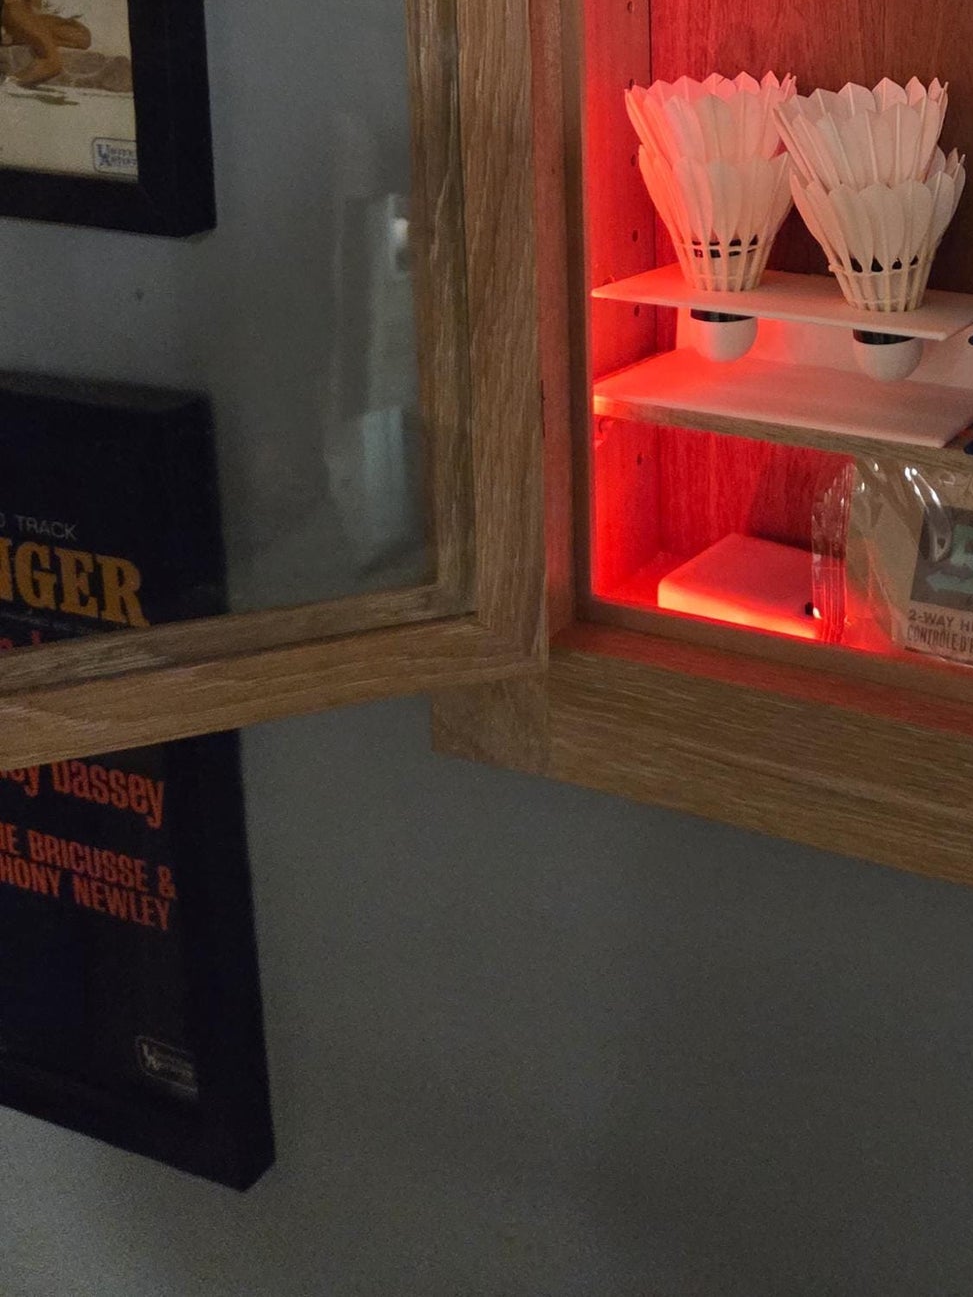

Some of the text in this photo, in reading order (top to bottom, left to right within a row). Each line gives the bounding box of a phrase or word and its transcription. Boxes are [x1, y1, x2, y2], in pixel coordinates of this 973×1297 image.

[14, 514, 78, 542] TRACK
[908, 608, 955, 628] 2-WAY
[28, 829, 149, 893] BRICUSSE
[72, 875, 170, 931] NEWLEY
